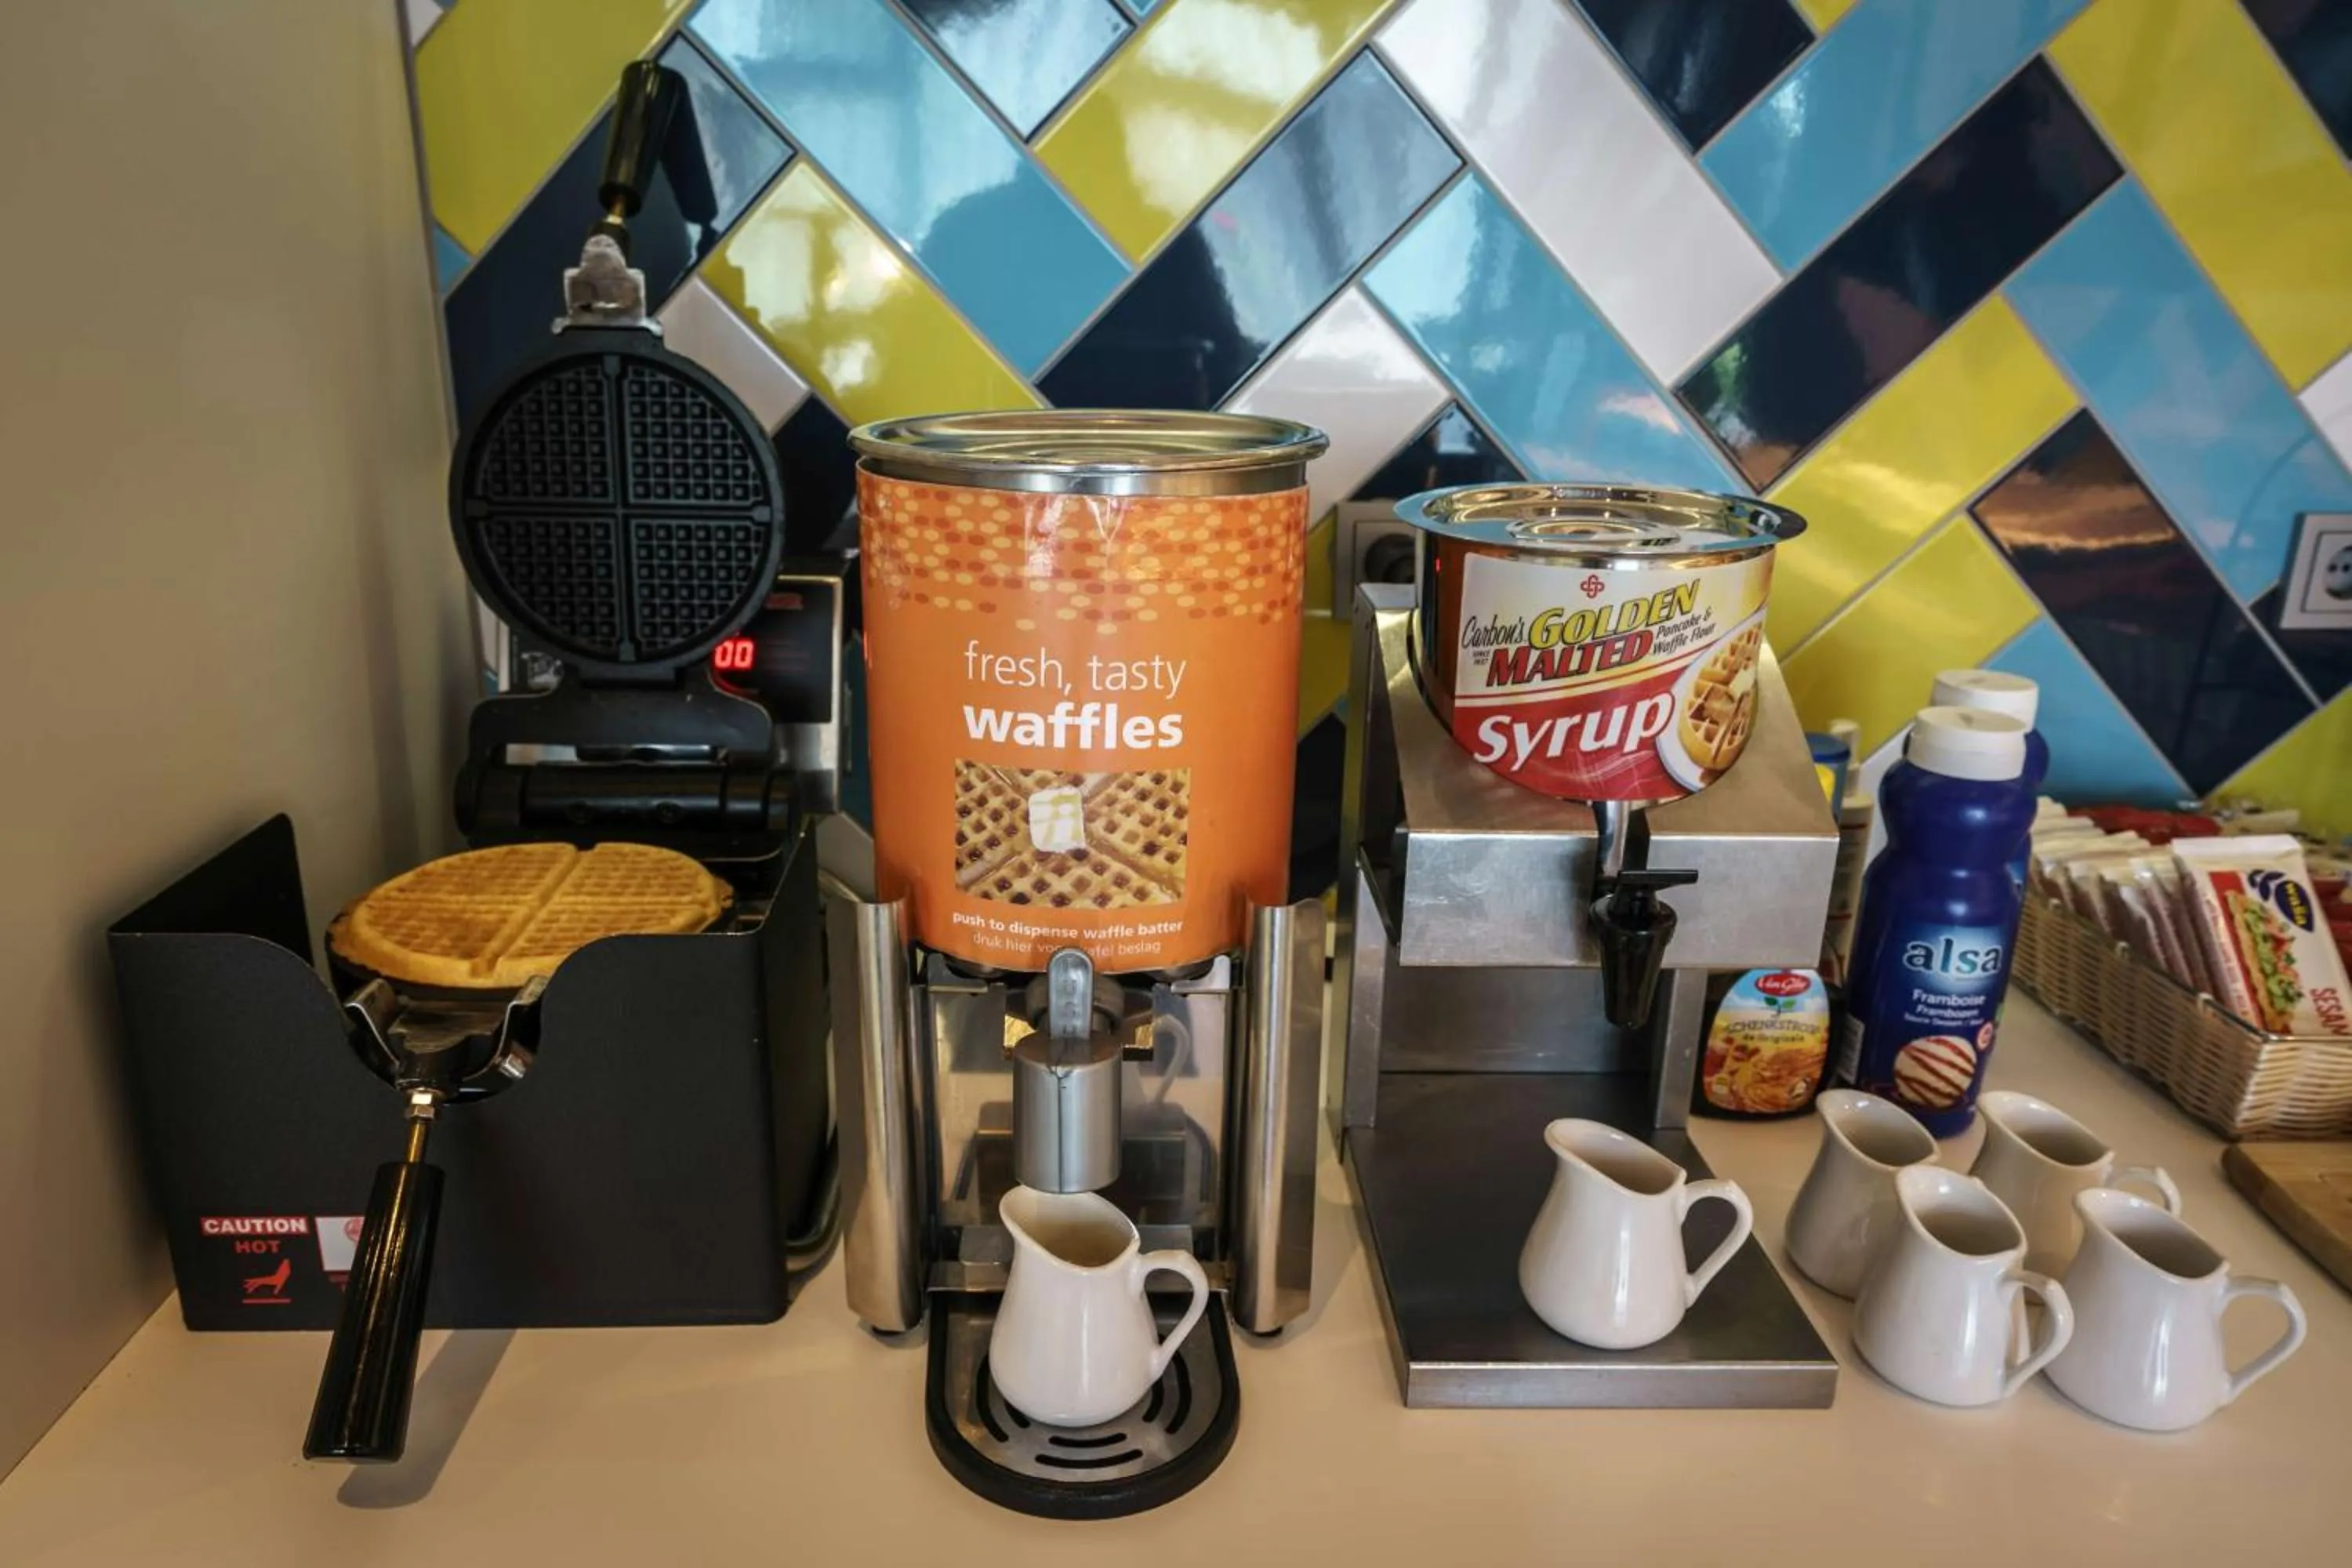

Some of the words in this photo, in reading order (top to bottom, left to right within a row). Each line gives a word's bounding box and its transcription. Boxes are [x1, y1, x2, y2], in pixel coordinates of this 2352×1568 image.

[1528, 579, 1700, 650] GOLDEN
[964, 640, 1072, 696] fresh,
[1087, 658, 1186, 699] tasty
[1486, 630, 1653, 687] MALTED
[963, 701, 1184, 750] waffles
[1473, 691, 1675, 771] Syrup
[953, 911, 985, 927] push
[989, 917, 1005, 931] to
[1009, 920, 1079, 939] dispense
[1083, 924, 1135, 939] waffle
[1138, 920, 1184, 936] batter
[973, 932, 1003, 949] druk
[1006, 938, 1032, 952] hier
[1118, 940, 1161, 955] beslag
[1902, 935, 2002, 975] alsa
[203, 1218, 308, 1234] CAUTION
[235, 1239, 281, 1254] HOT
